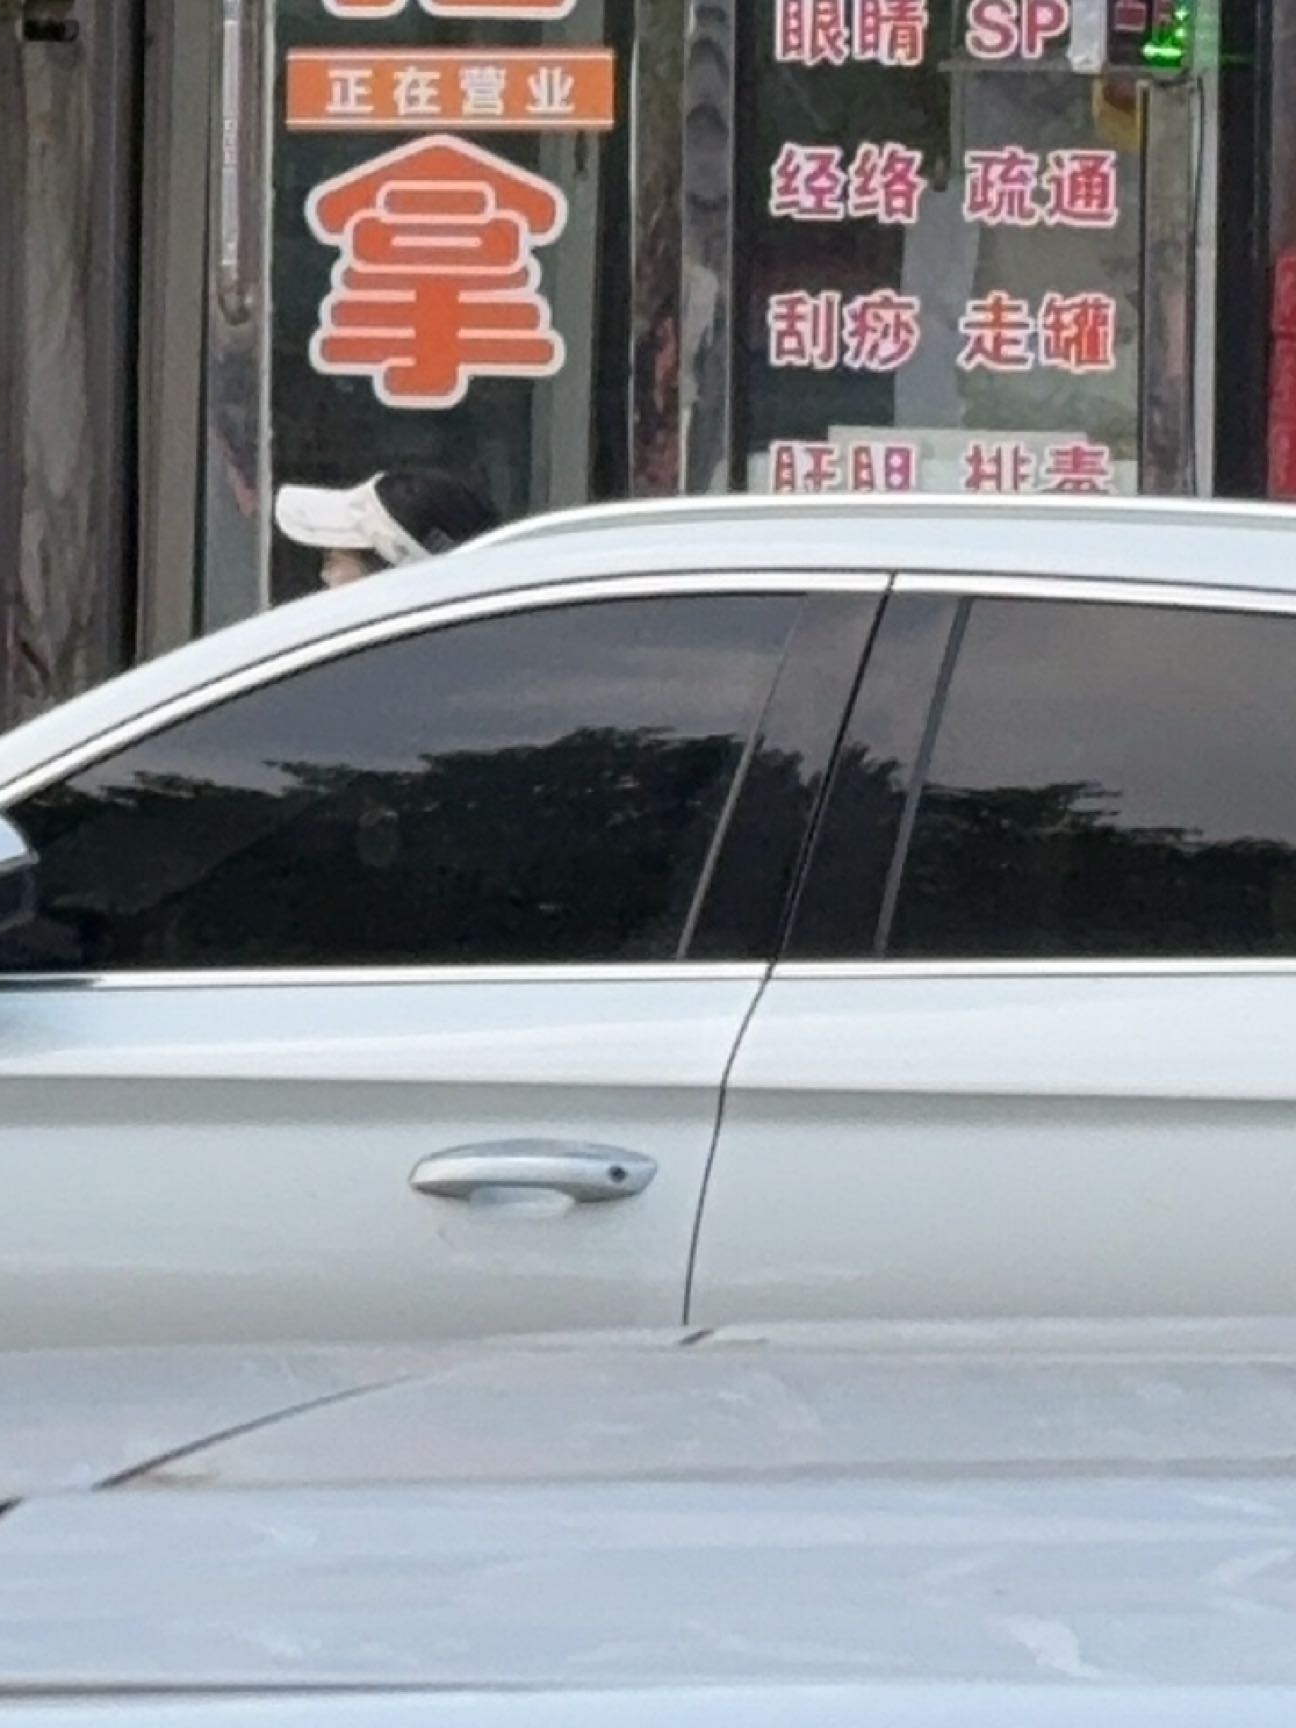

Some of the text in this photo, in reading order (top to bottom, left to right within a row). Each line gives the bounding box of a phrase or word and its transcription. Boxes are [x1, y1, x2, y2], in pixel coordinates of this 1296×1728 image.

[326, 66, 576, 117] 正在营业
[770, 140, 1118, 228] 经络 疏通
[305, 134, 568, 410] 拿
[957, 290, 1116, 375] 走罐
